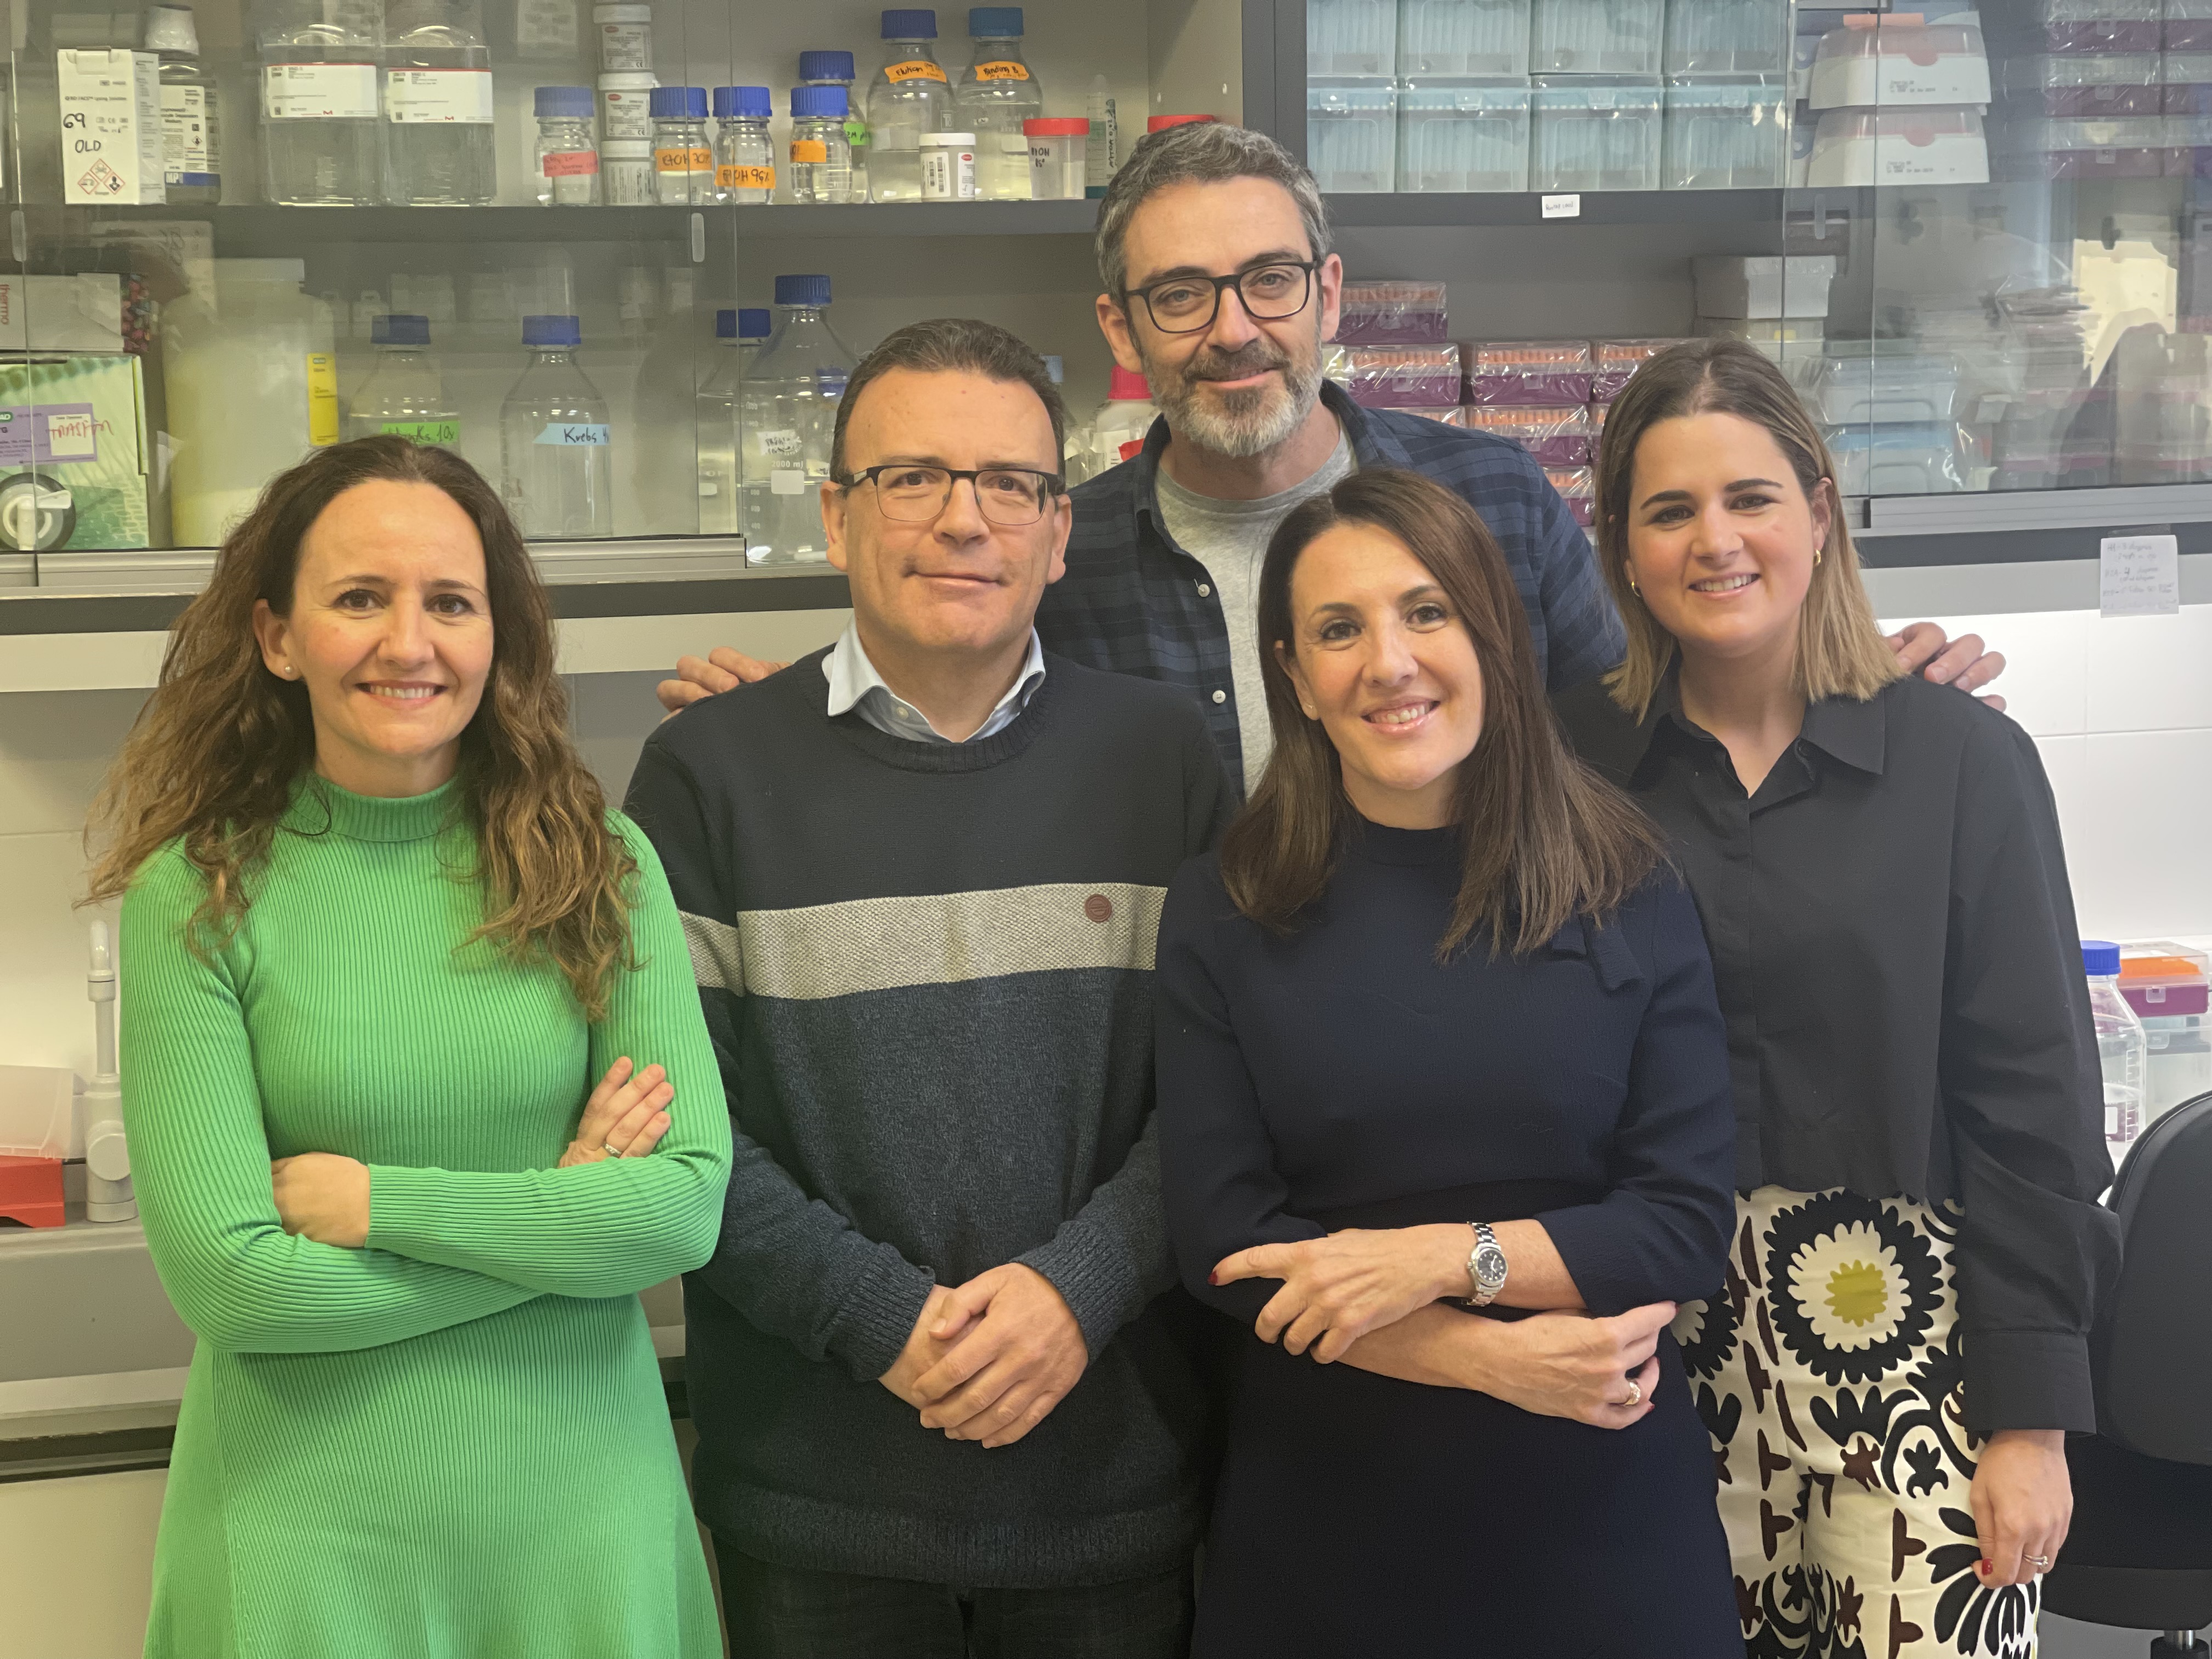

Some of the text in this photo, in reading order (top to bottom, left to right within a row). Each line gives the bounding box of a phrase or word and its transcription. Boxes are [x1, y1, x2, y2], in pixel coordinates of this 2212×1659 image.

[63, 112, 86, 128] 69
[75, 139, 101, 153] OLD
[563, 426, 597, 443] Krebs
